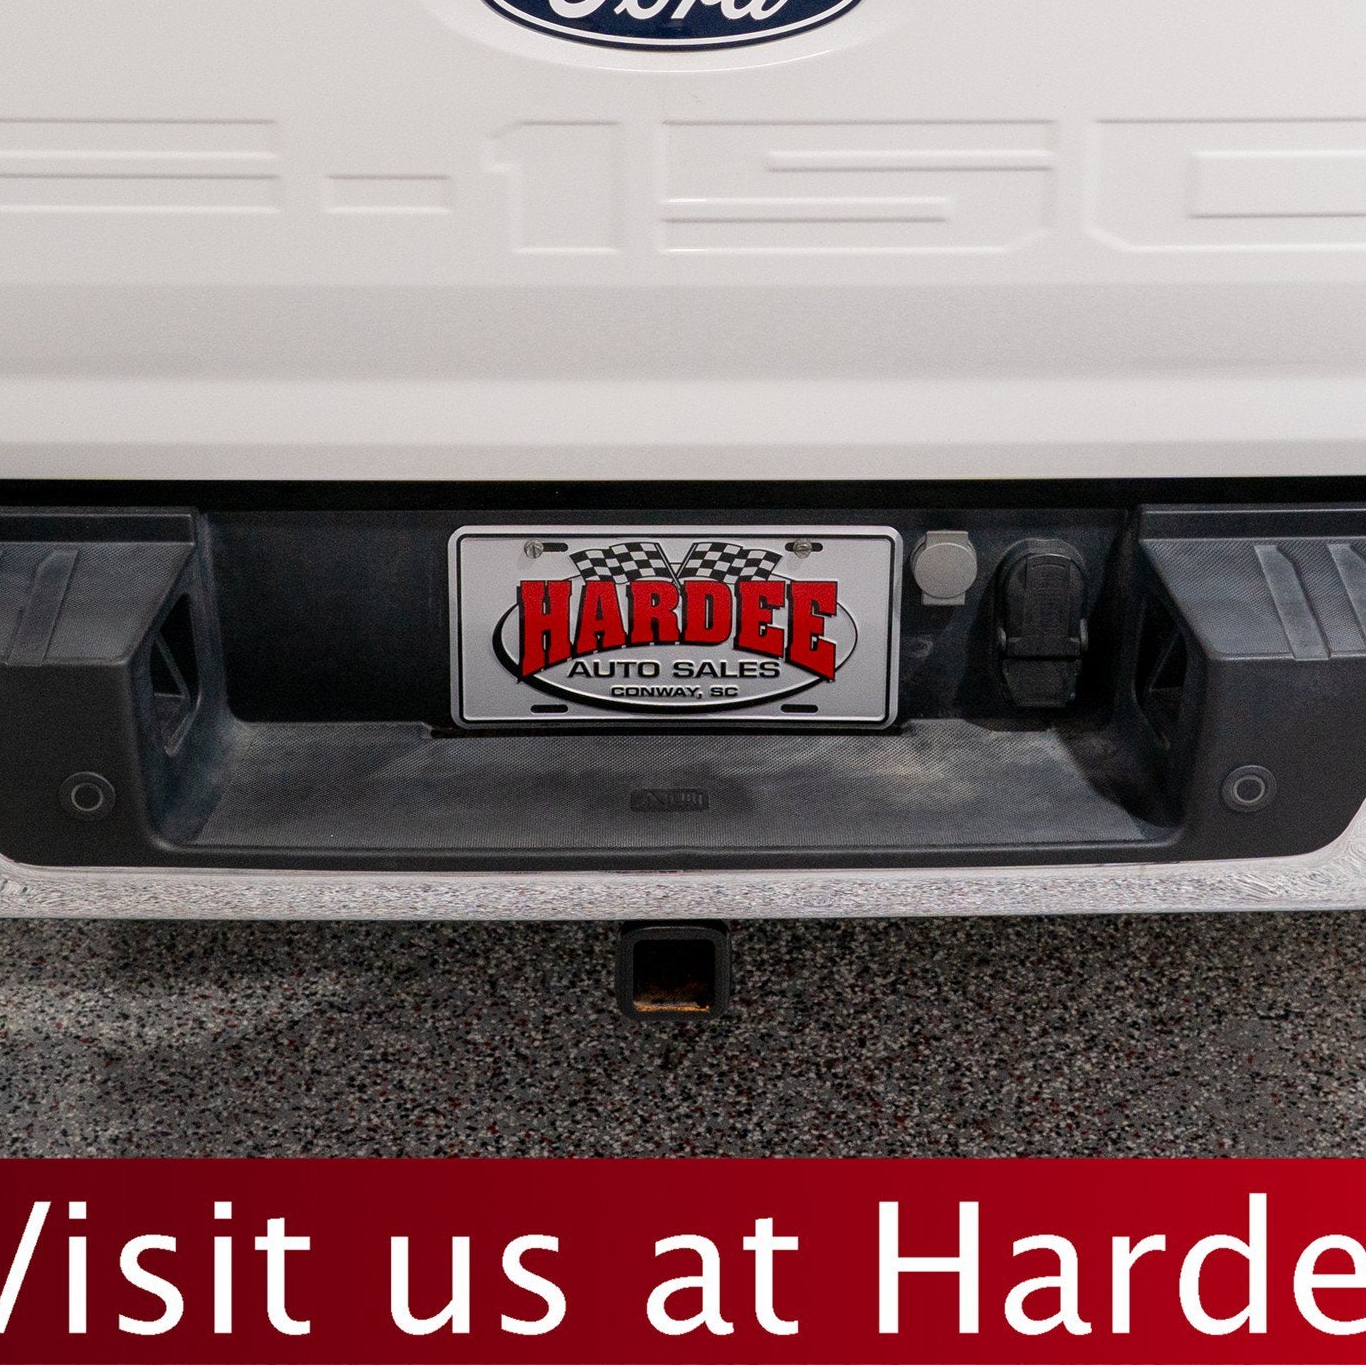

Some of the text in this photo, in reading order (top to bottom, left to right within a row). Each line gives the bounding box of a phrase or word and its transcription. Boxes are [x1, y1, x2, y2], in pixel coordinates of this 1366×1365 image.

[516, 580, 838, 682] HARDEE
[566, 659, 781, 679] AUTO SALES
[610, 686, 739, 699] CONWAY, SC
